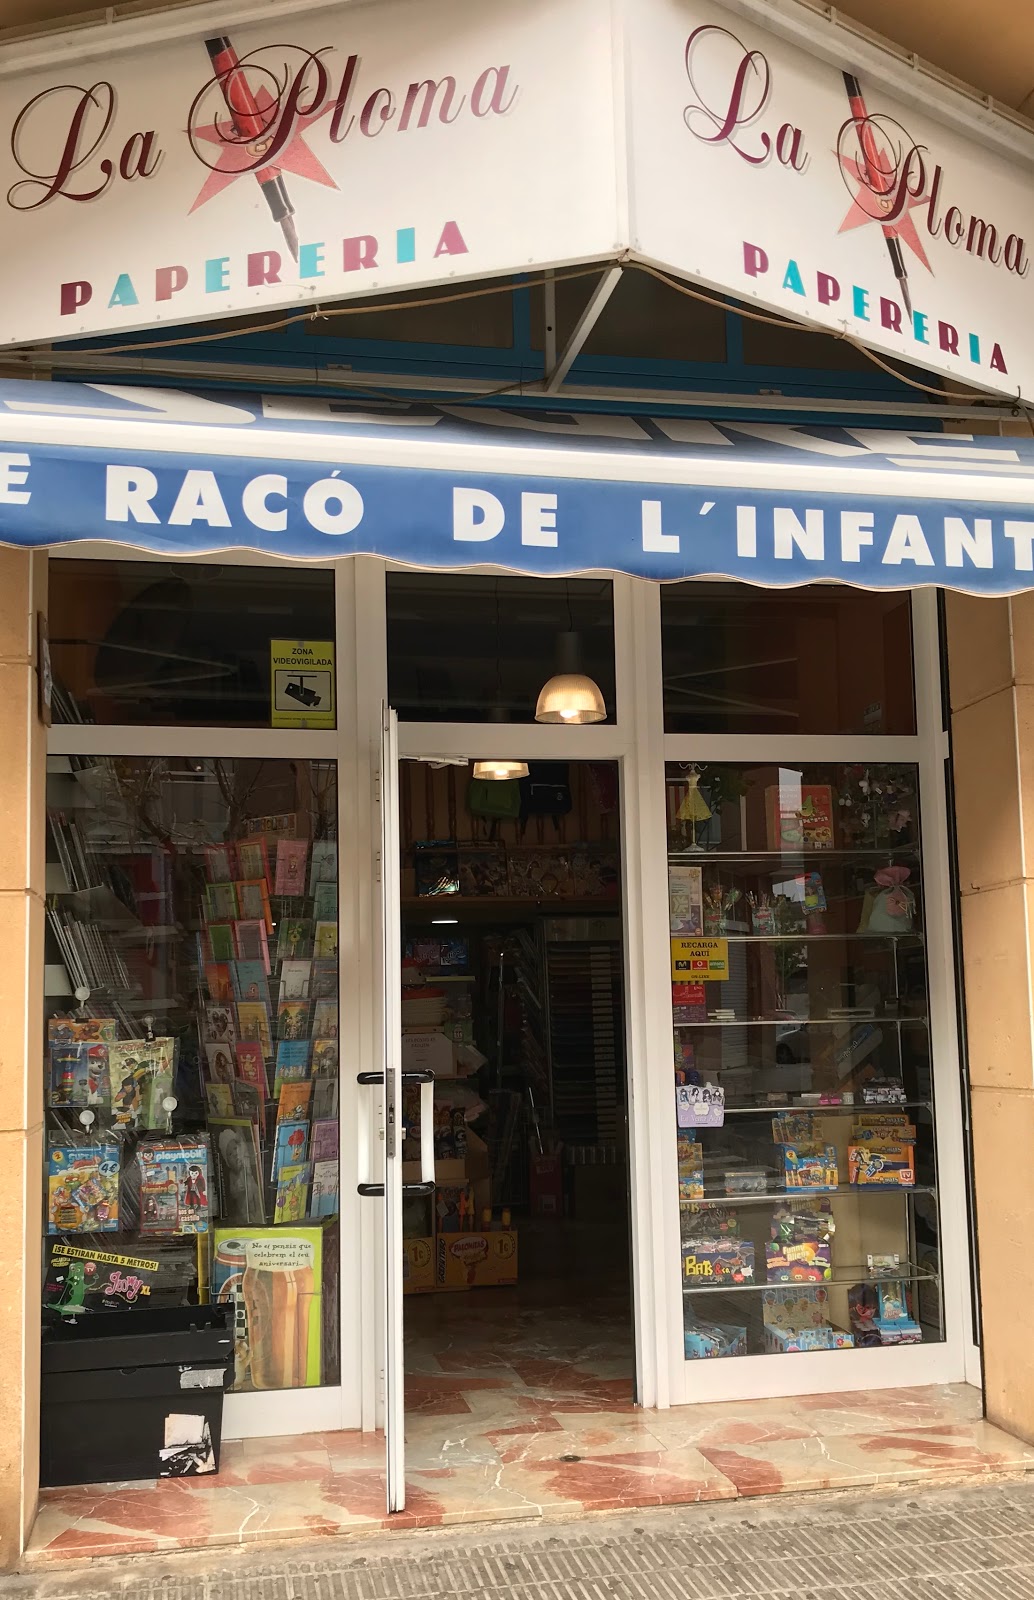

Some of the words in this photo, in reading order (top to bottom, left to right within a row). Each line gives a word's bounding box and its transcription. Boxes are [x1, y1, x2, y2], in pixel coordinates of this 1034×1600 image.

[8, 82, 161, 210] La
[187, 44, 518, 174] Ploma
[683, 24, 809, 171] La
[837, 113, 1030, 276] Ploma
[59, 221, 470, 316] PAPERERIA
[741, 241, 1009, 375] PAPERERIA
[105, 469, 364, 536] RACÓ
[452, 486, 560, 548] DE
[272, 657, 333, 666] VIDEOVIGILADA
[291, 647, 314, 656] ZONA
[689, 949, 710, 957] AQUÍ
[66, 1248, 95, 1258] ESTIRAN
[96, 1253, 119, 1263] HASTA
[126, 1258, 157, 1270] METROS!
[140, 1285, 151, 1296] XL
